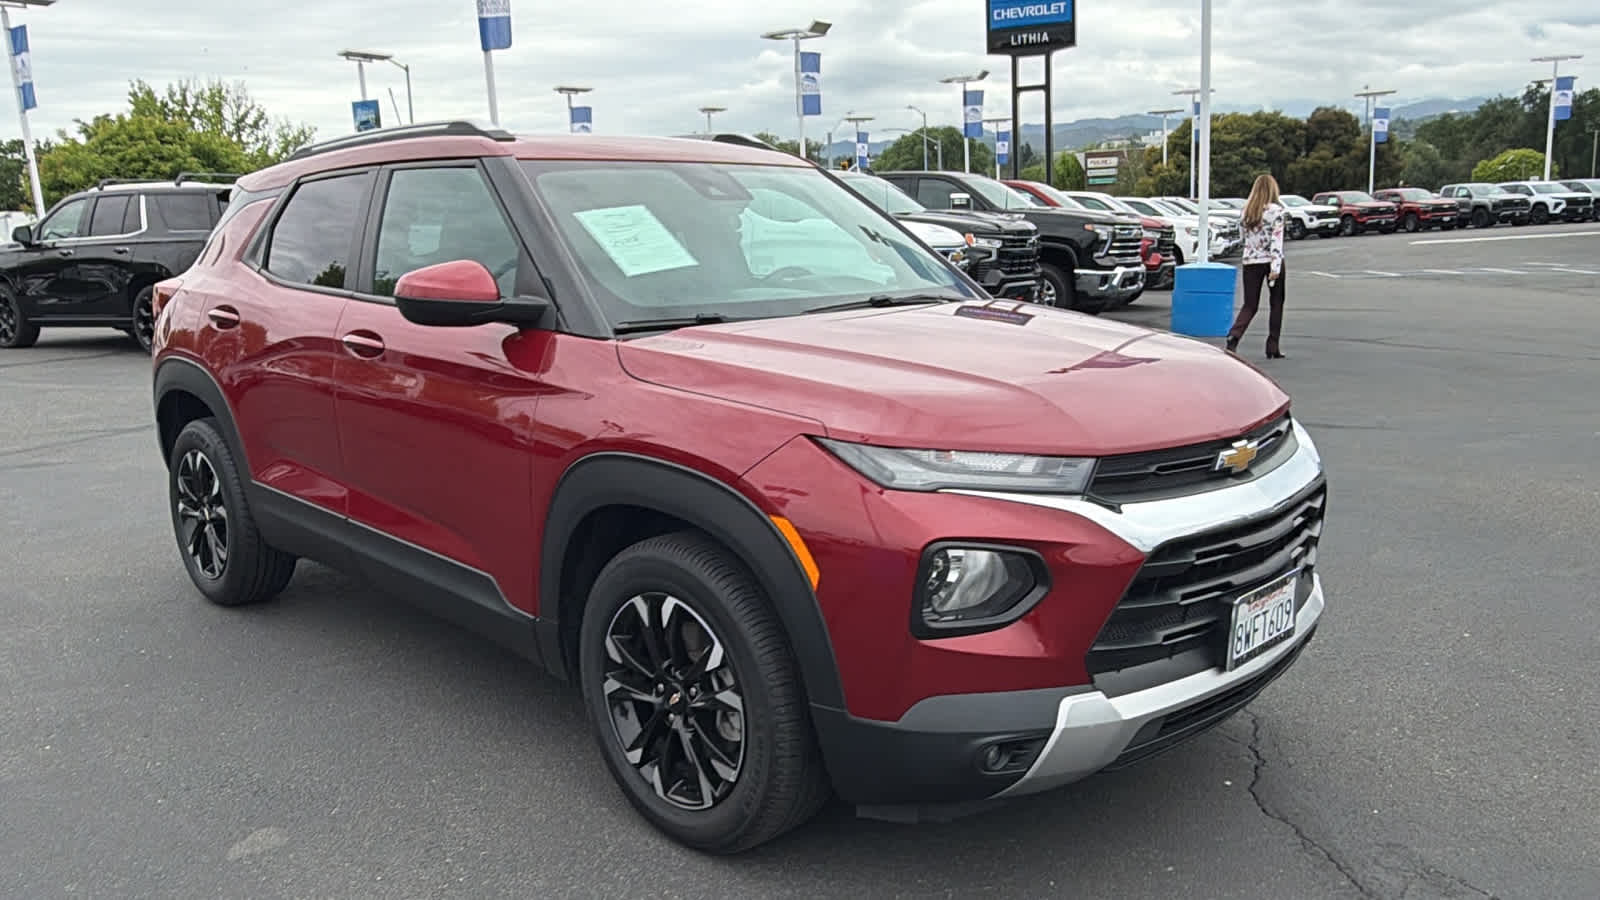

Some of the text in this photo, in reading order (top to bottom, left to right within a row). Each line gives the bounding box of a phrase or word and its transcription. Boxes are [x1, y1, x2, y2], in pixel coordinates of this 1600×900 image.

[993, 2, 1066, 20] CHEVROLET
[1010, 31, 1049, 46] LITHIA
[1234, 598, 1292, 655] 8WFT609
